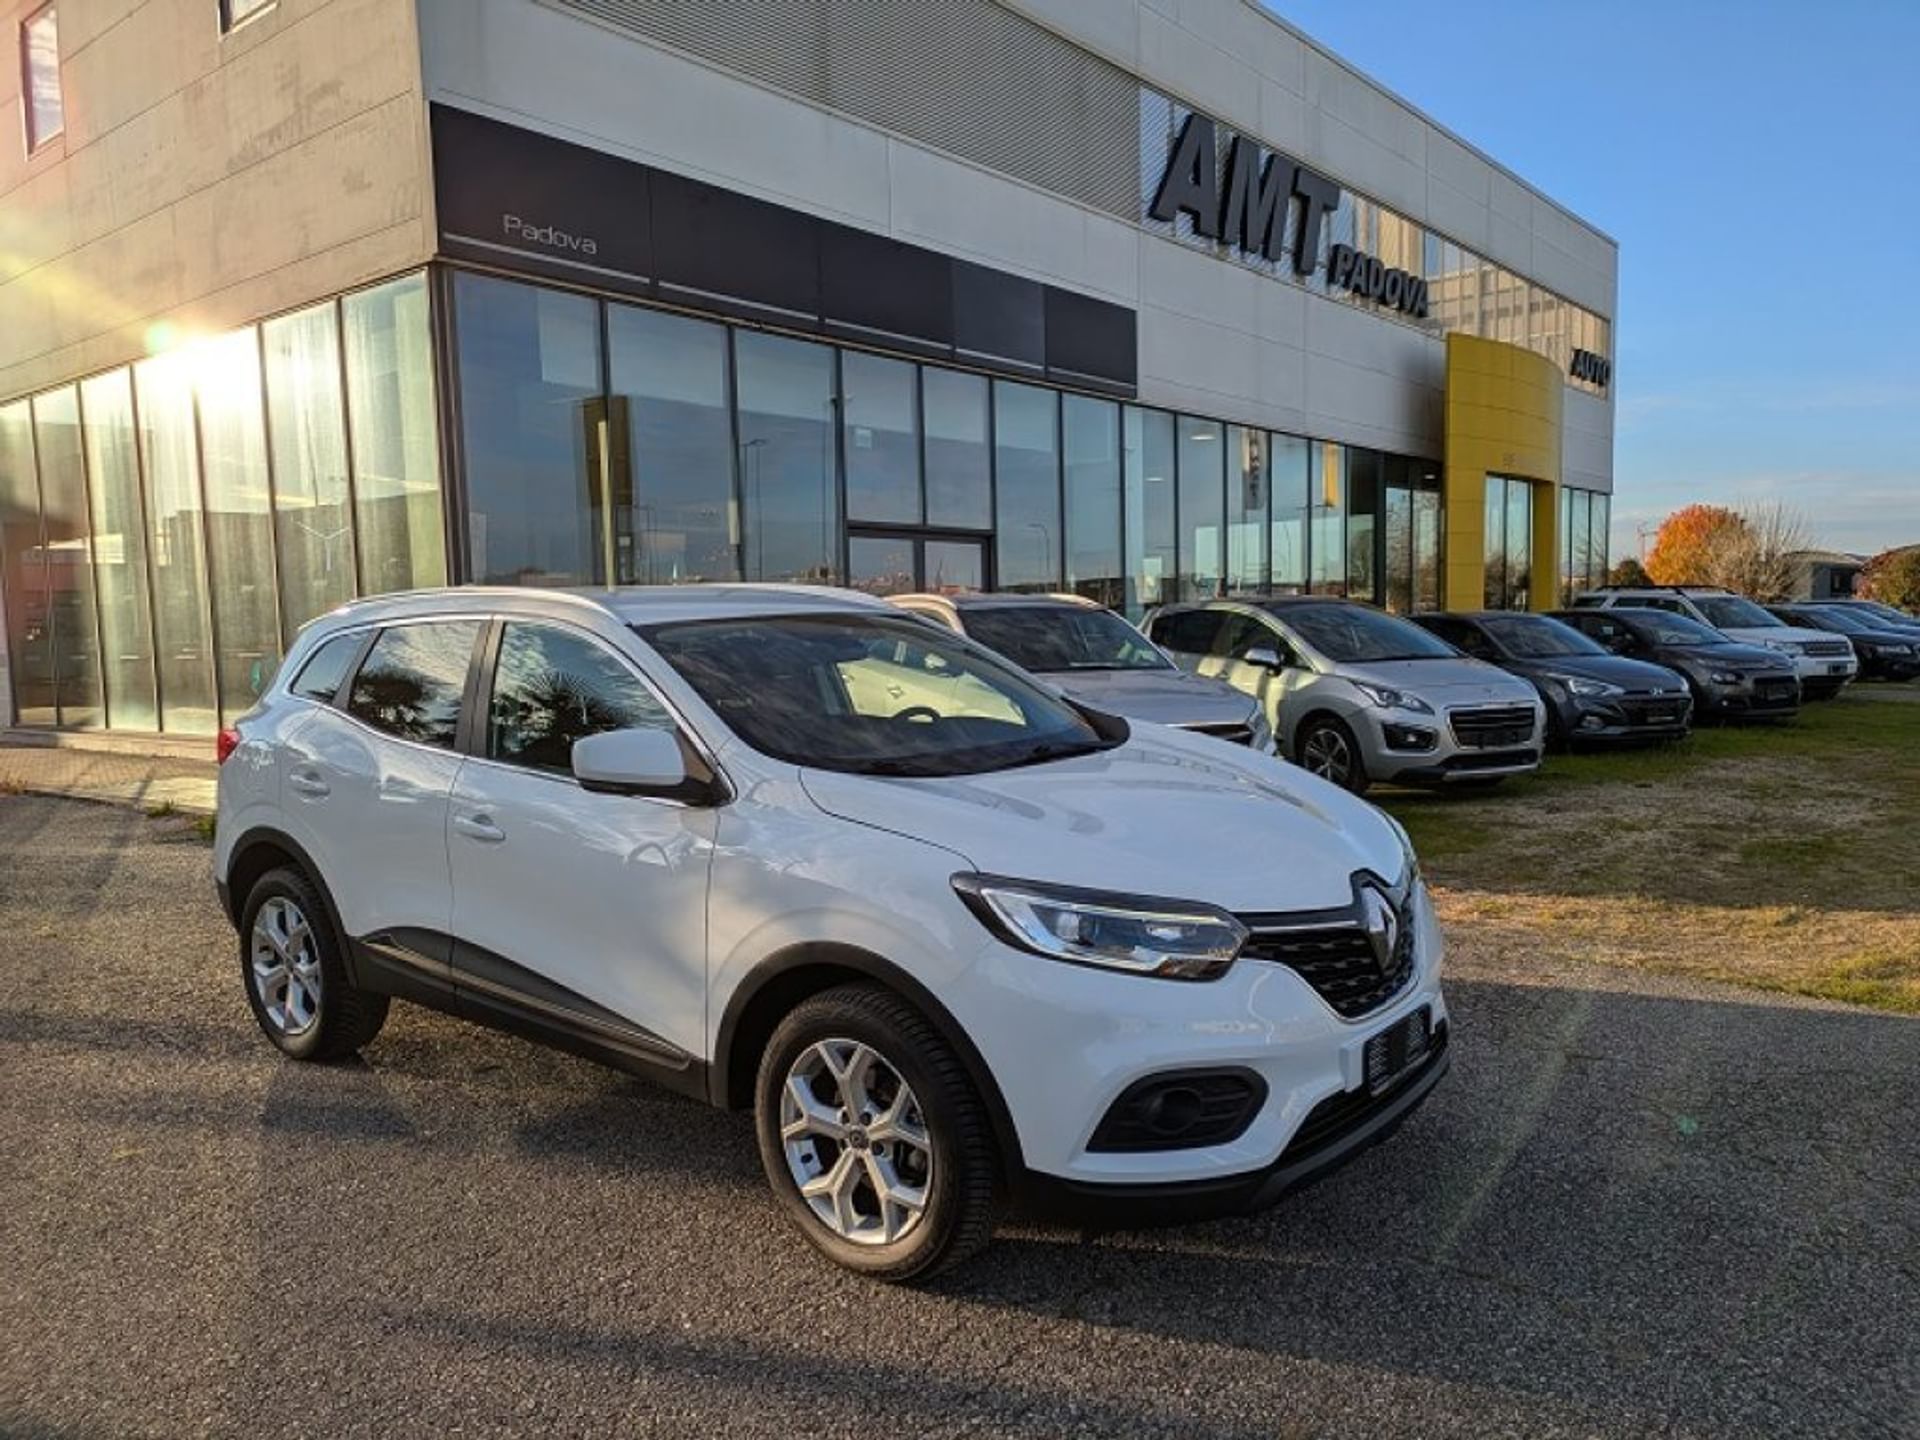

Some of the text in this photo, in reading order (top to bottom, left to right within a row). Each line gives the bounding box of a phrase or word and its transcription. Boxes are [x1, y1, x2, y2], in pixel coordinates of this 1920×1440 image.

[503, 213, 598, 255] Padova
[1148, 112, 1428, 318] AMT PADOVA
